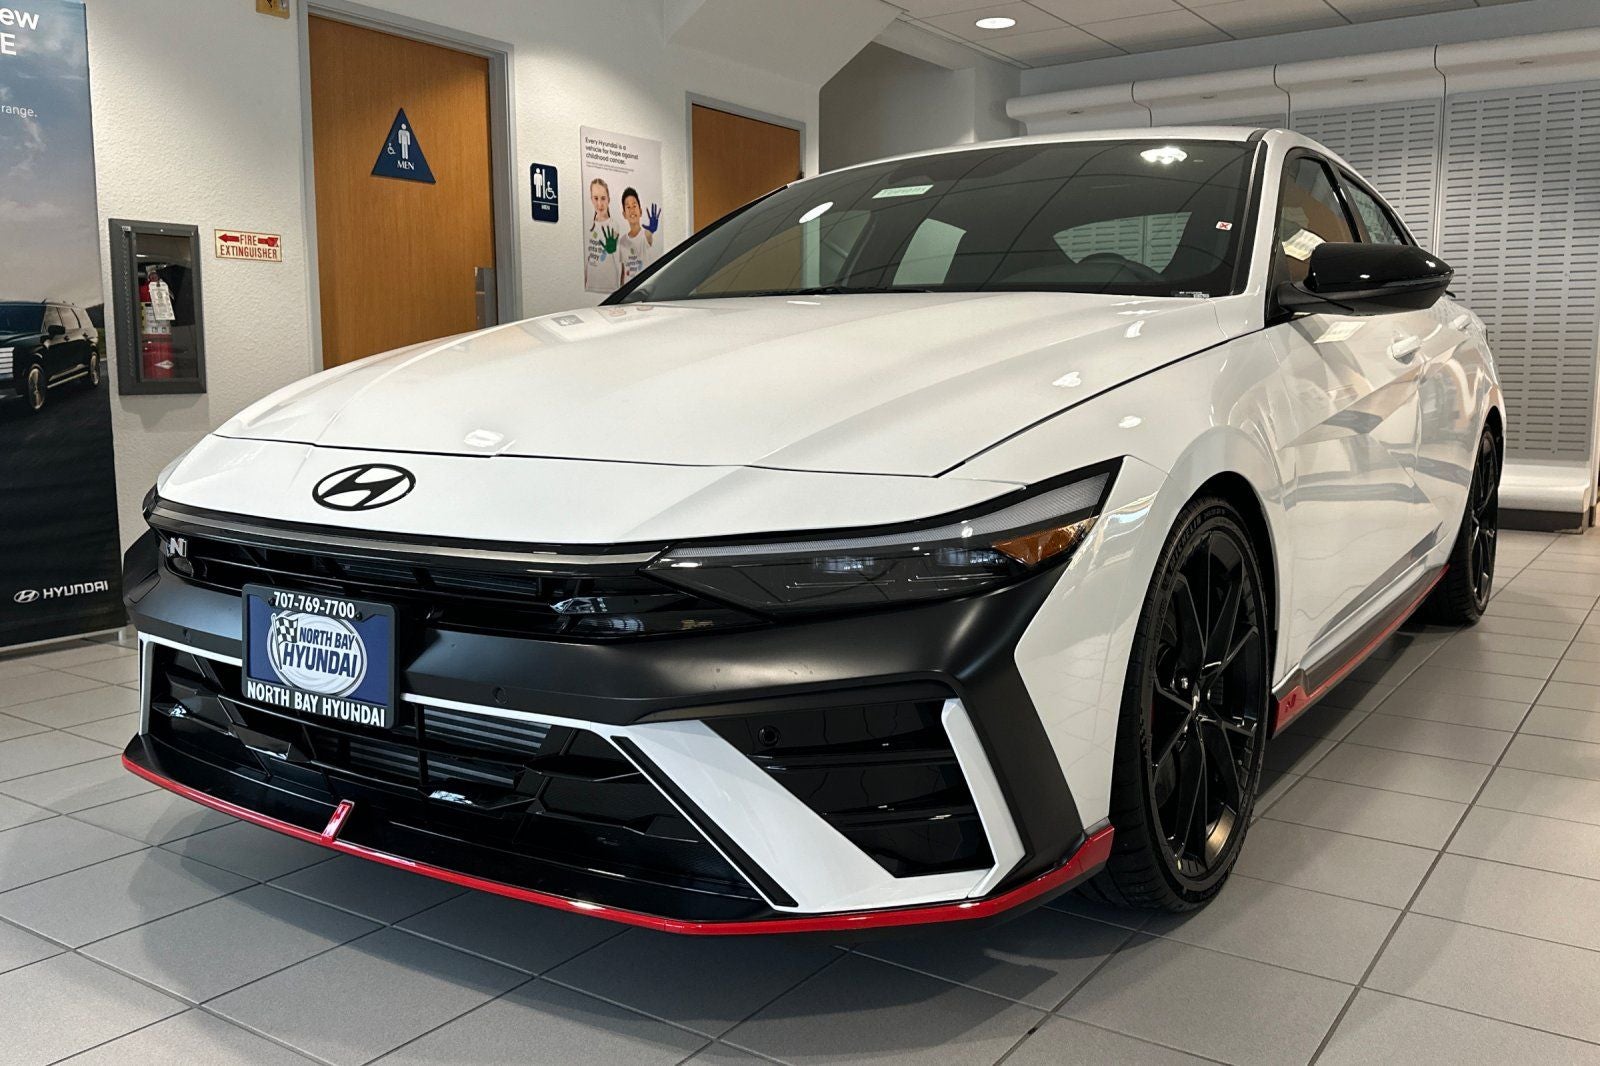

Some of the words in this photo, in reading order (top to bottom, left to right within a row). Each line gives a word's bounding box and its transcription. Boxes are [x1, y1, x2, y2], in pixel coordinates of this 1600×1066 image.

[1, 104, 38, 119] range.
[585, 137, 598, 145] Every
[598, 140, 618, 149] Hyundai
[586, 152, 608, 162] childhood
[622, 152, 639, 160] against
[397, 160, 415, 170] MEN
[240, 234, 258, 246] FIRE
[220, 244, 278, 259] EXTINGUISHER
[43, 580, 109, 599] HYUNDAI
[273, 591, 356, 618] 707-769-7700
[299, 626, 333, 648] NORTH
[335, 632, 356, 650] BAY
[282, 643, 358, 678] HYUNDAI
[247, 681, 290, 708] NORTH
[294, 692, 319, 716] BAY
[322, 697, 386, 728] HYUNDAI
